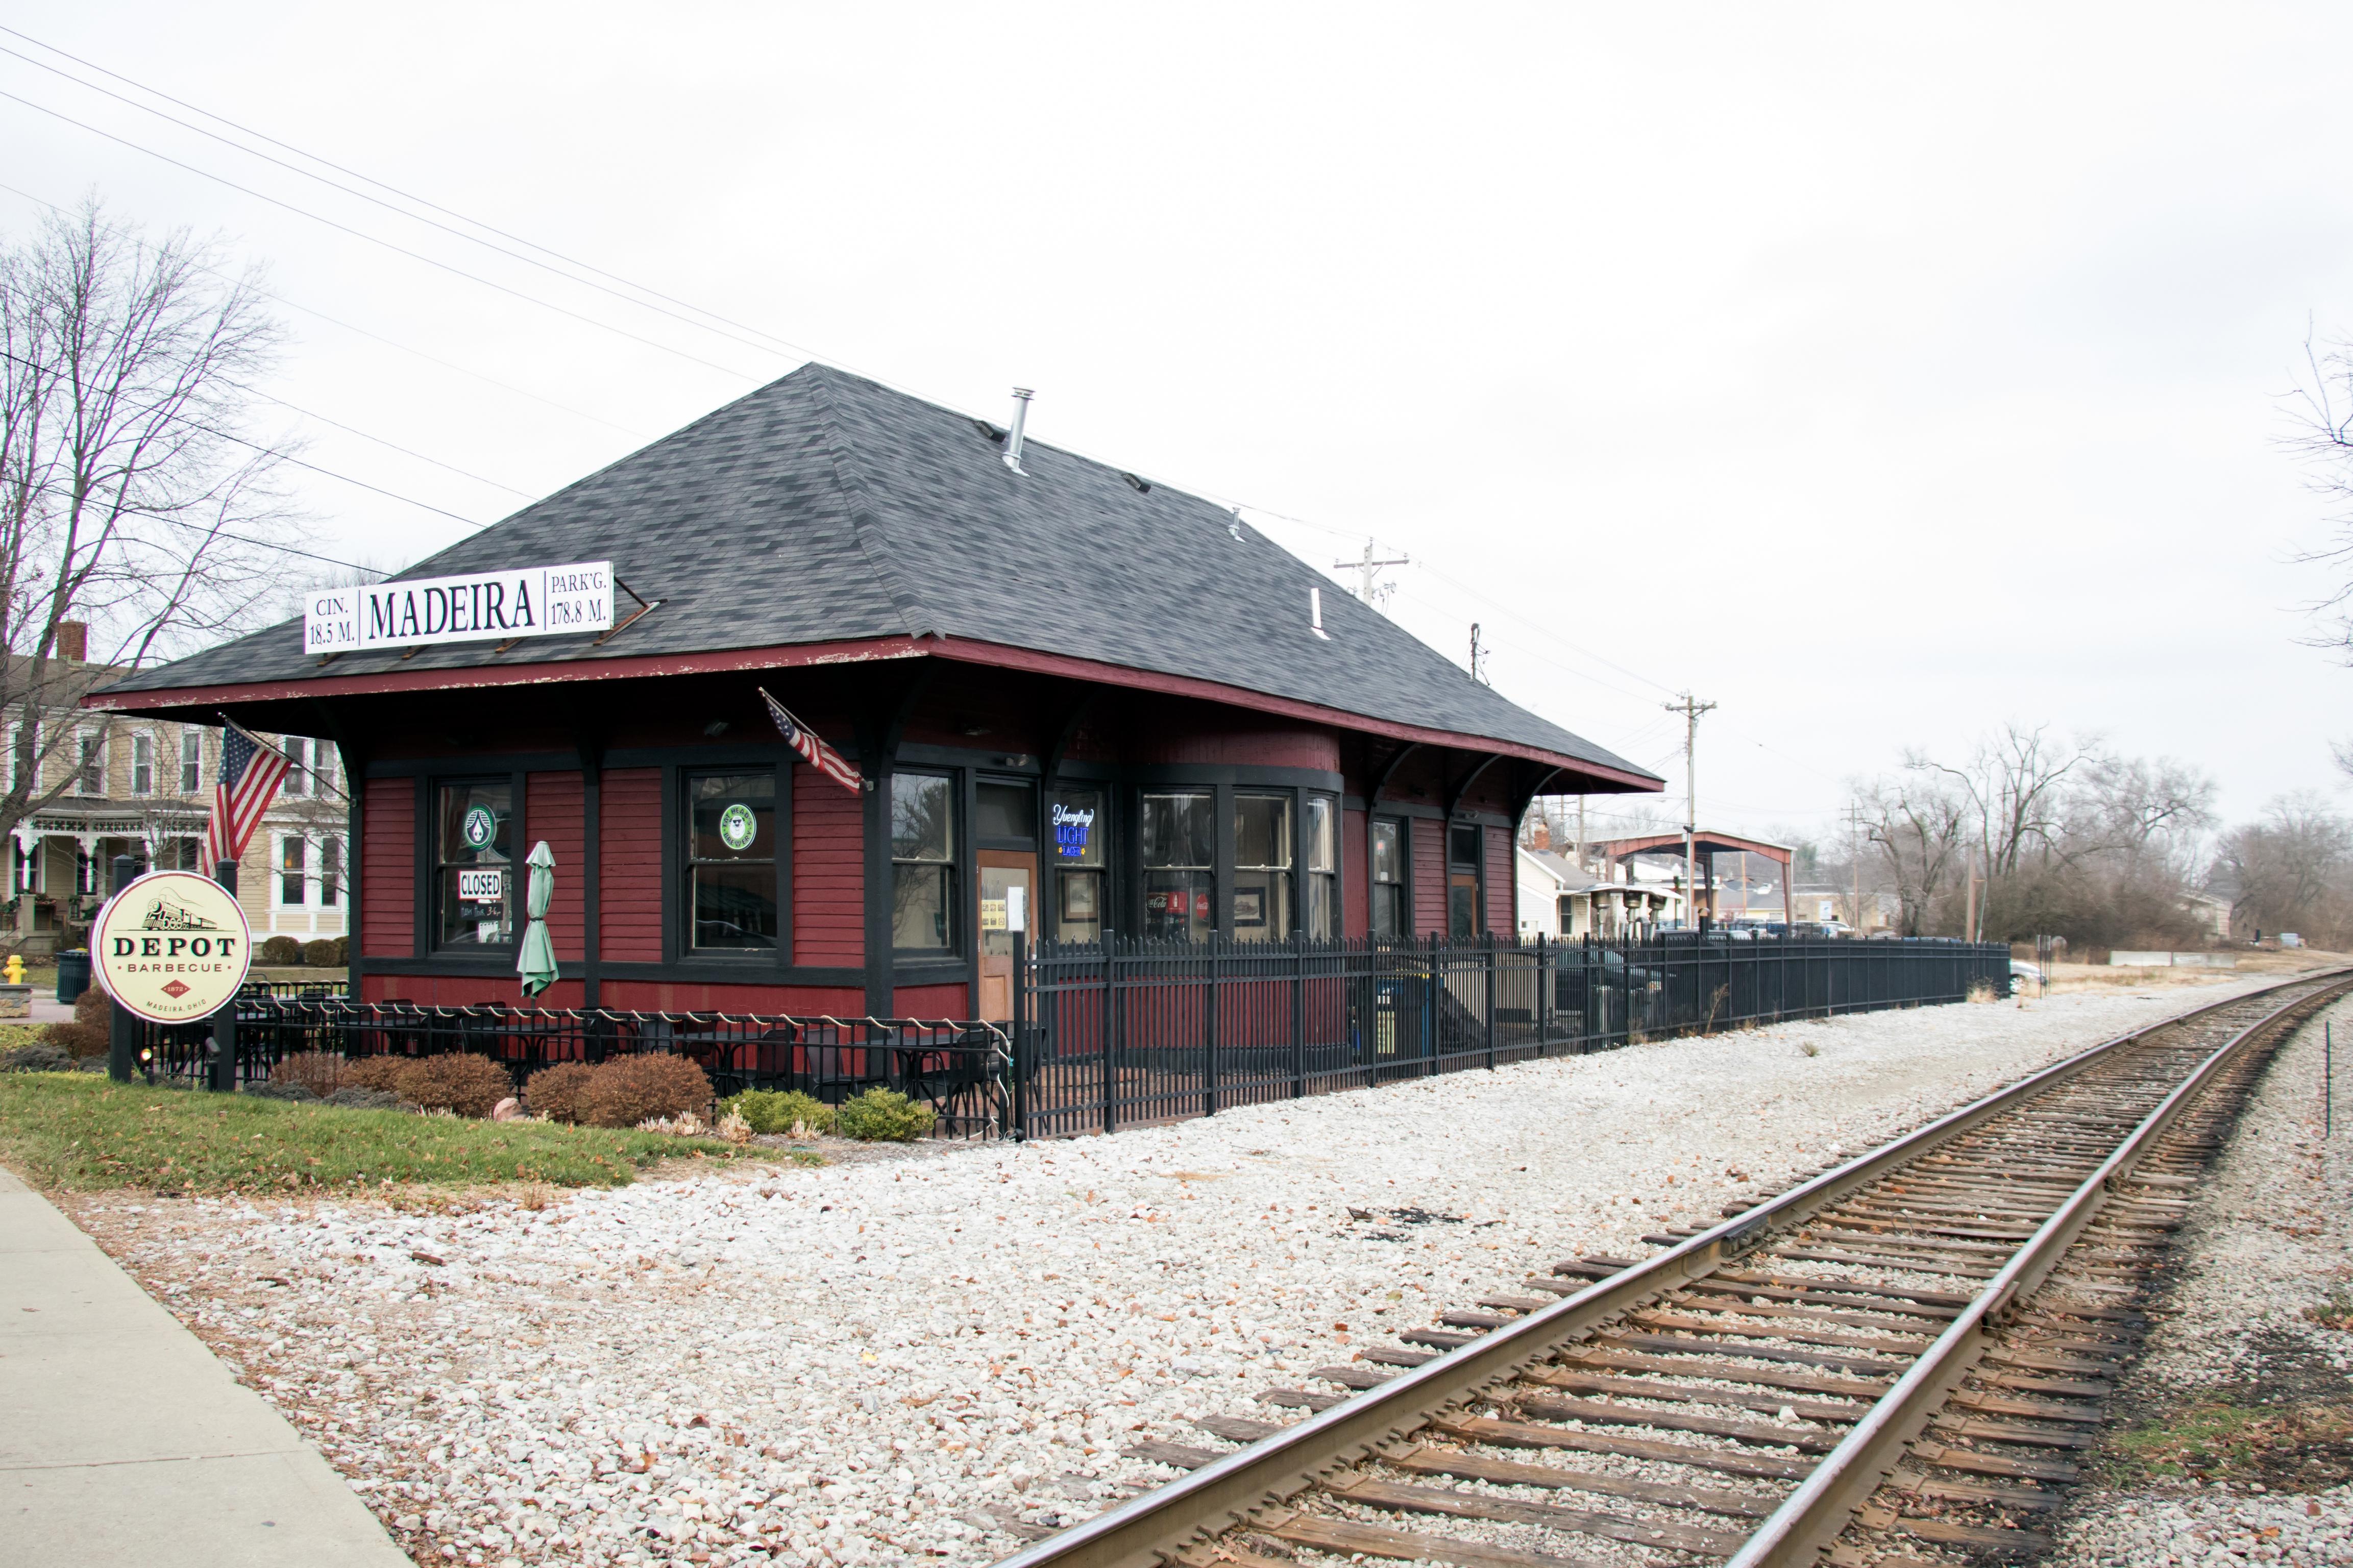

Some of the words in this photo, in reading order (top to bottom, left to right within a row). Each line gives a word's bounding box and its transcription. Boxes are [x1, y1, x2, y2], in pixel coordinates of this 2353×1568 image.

[552, 572, 606, 593] PARK'G.
[316, 598, 348, 616] CIN.
[369, 580, 536, 640] MADEIRA
[551, 600, 582, 625] 178.8
[589, 599, 606, 622] M.
[310, 623, 332, 645] 18.5
[338, 621, 354, 642] M.
[1053, 804, 1094, 827] Yuengling
[725, 831, 751, 846] BREWERY
[1058, 825, 1089, 844] LIGHT
[1062, 845, 1082, 856] LAGER
[461, 874, 500, 895] CLOSED
[113, 937, 237, 958] DEPOT
[128, 964, 222, 972] BARBECUE
[187, 998, 206, 1010] OHIO
